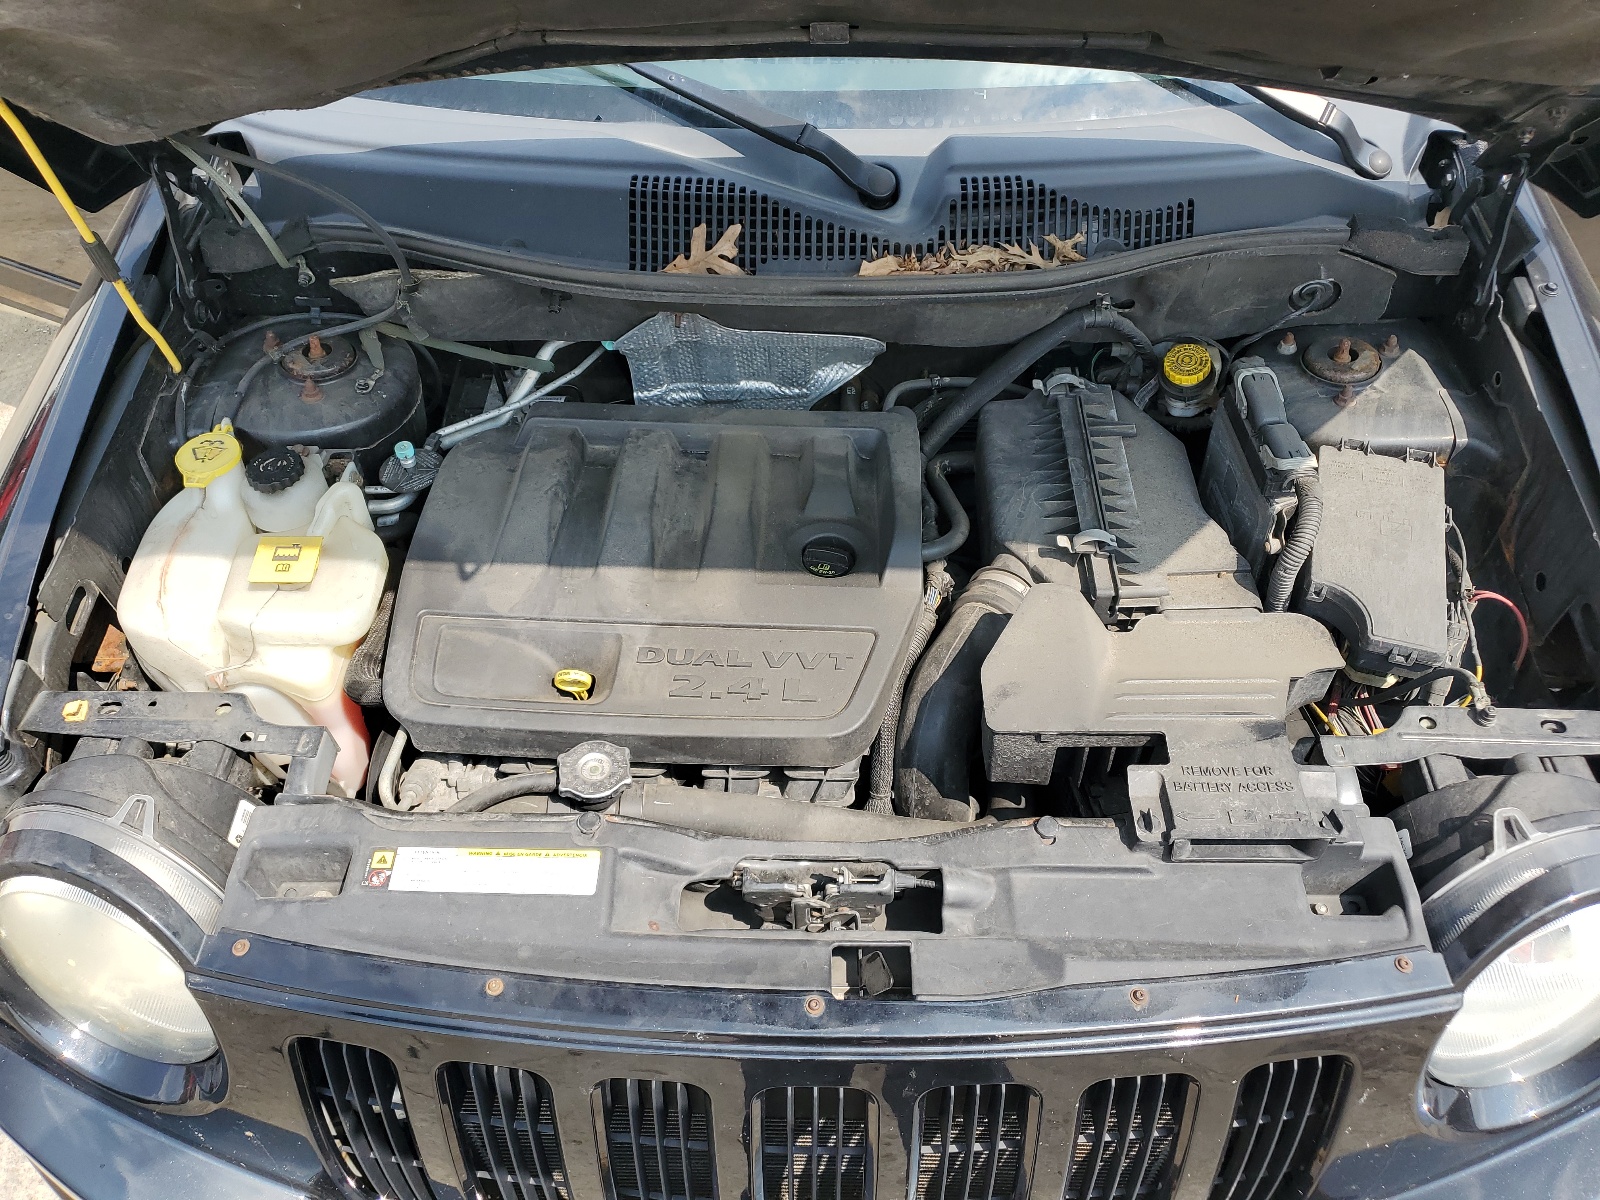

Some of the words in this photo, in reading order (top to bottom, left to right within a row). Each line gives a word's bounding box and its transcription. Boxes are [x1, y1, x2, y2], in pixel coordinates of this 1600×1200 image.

[635, 646, 753, 668] DUAL
[761, 650, 855, 671] VVT
[1180, 765, 1242, 777] REMOVE
[1243, 765, 1275, 777] FOR
[1173, 780, 1232, 793] BATTERY
[1238, 780, 1296, 793] ACCESS
